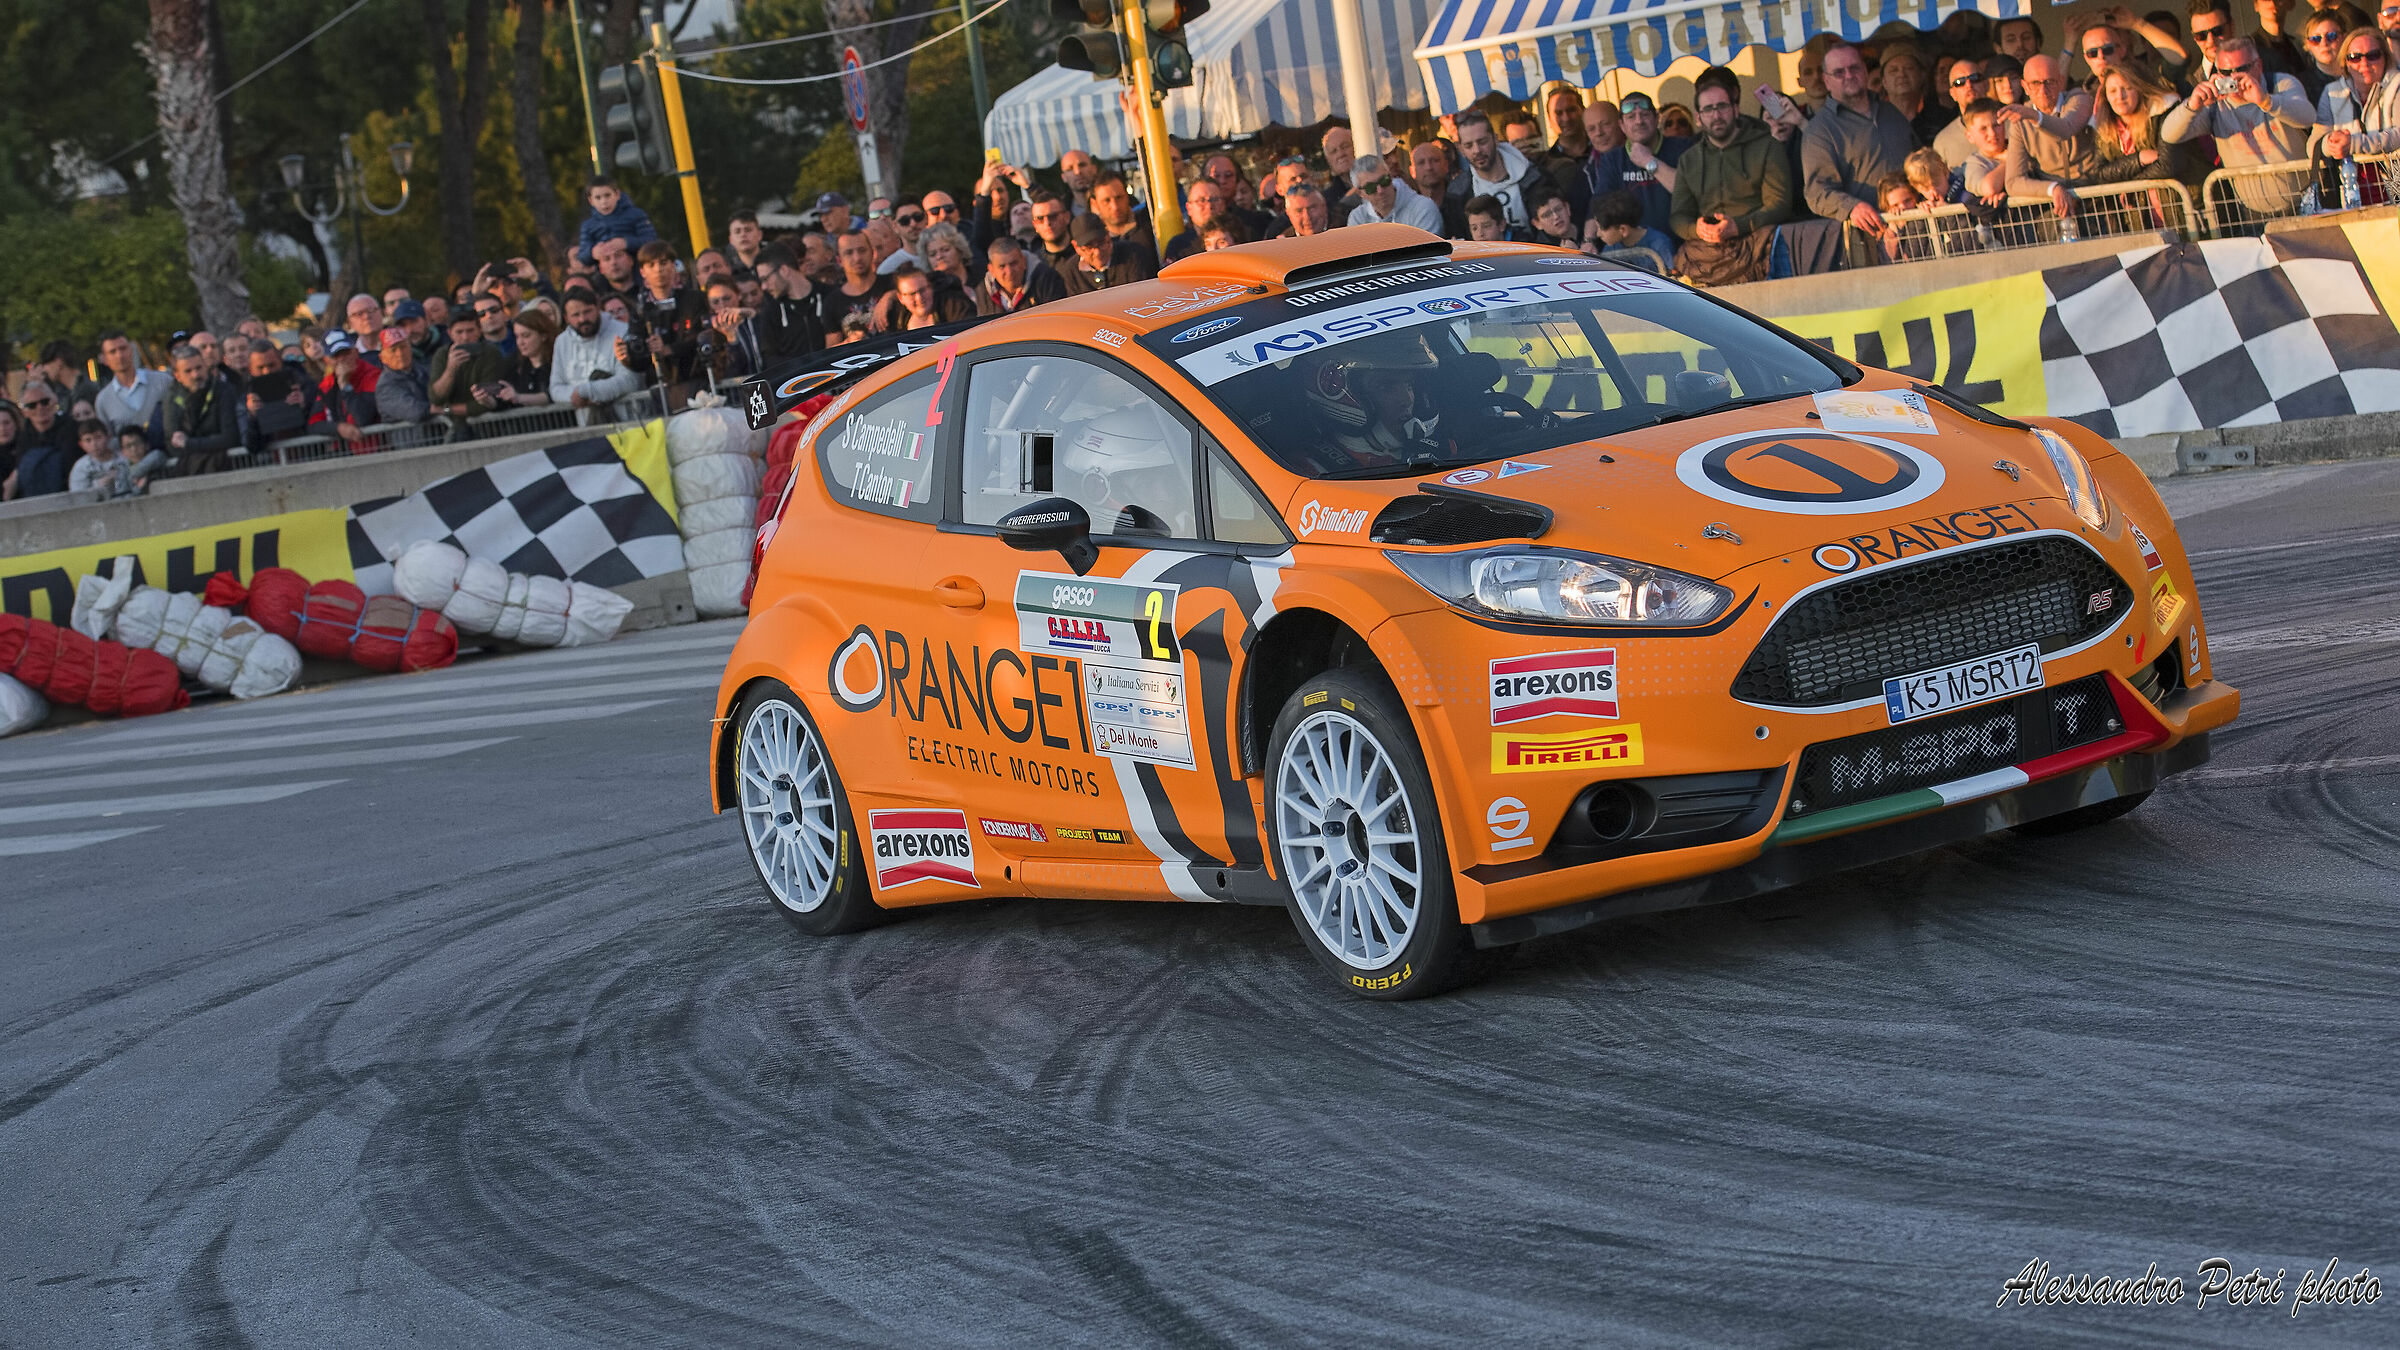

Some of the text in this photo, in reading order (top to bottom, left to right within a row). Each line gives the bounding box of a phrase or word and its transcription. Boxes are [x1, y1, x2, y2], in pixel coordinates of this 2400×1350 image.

[1554, 0, 1957, 73] GIOCATTO
[1285, 262, 1496, 308] ORANGE1RACING.EU
[1558, 278, 1662, 295] CIR
[1092, 327, 1128, 347] sparco
[1183, 318, 1233, 340] Ford
[925, 341, 959, 428] 2
[841, 412, 855, 449] S
[852, 414, 907, 462] Campedelli
[850, 462, 894, 505] T Canton
[1006, 511, 1070, 526] #WEAREPASSION
[1811, 504, 2040, 575] ORANGE1
[1051, 584, 1095, 610] gesco
[1048, 616, 1112, 645] C.E.L.F.A.
[1144, 590, 1171, 660] 2
[1094, 644, 1111, 654] LUCCA
[828, 623, 1091, 754] ORANGE1
[1107, 674, 1160, 693] Italiana Servizi
[1494, 669, 1613, 697] arexons
[1904, 650, 2040, 715] K5 MSRT2
[1891, 705, 1903, 715] PL
[1109, 727, 1159, 749] Del Monte
[1507, 733, 1629, 766] PIRELLI
[1830, 693, 2087, 794] M-SPOT
[908, 735, 1100, 798] ELECTRIC MOTORS
[981, 819, 1030, 839] FONDERMAT
[1056, 827, 1121, 843] PROJECT TEAM
[876, 832, 970, 858] arexons
